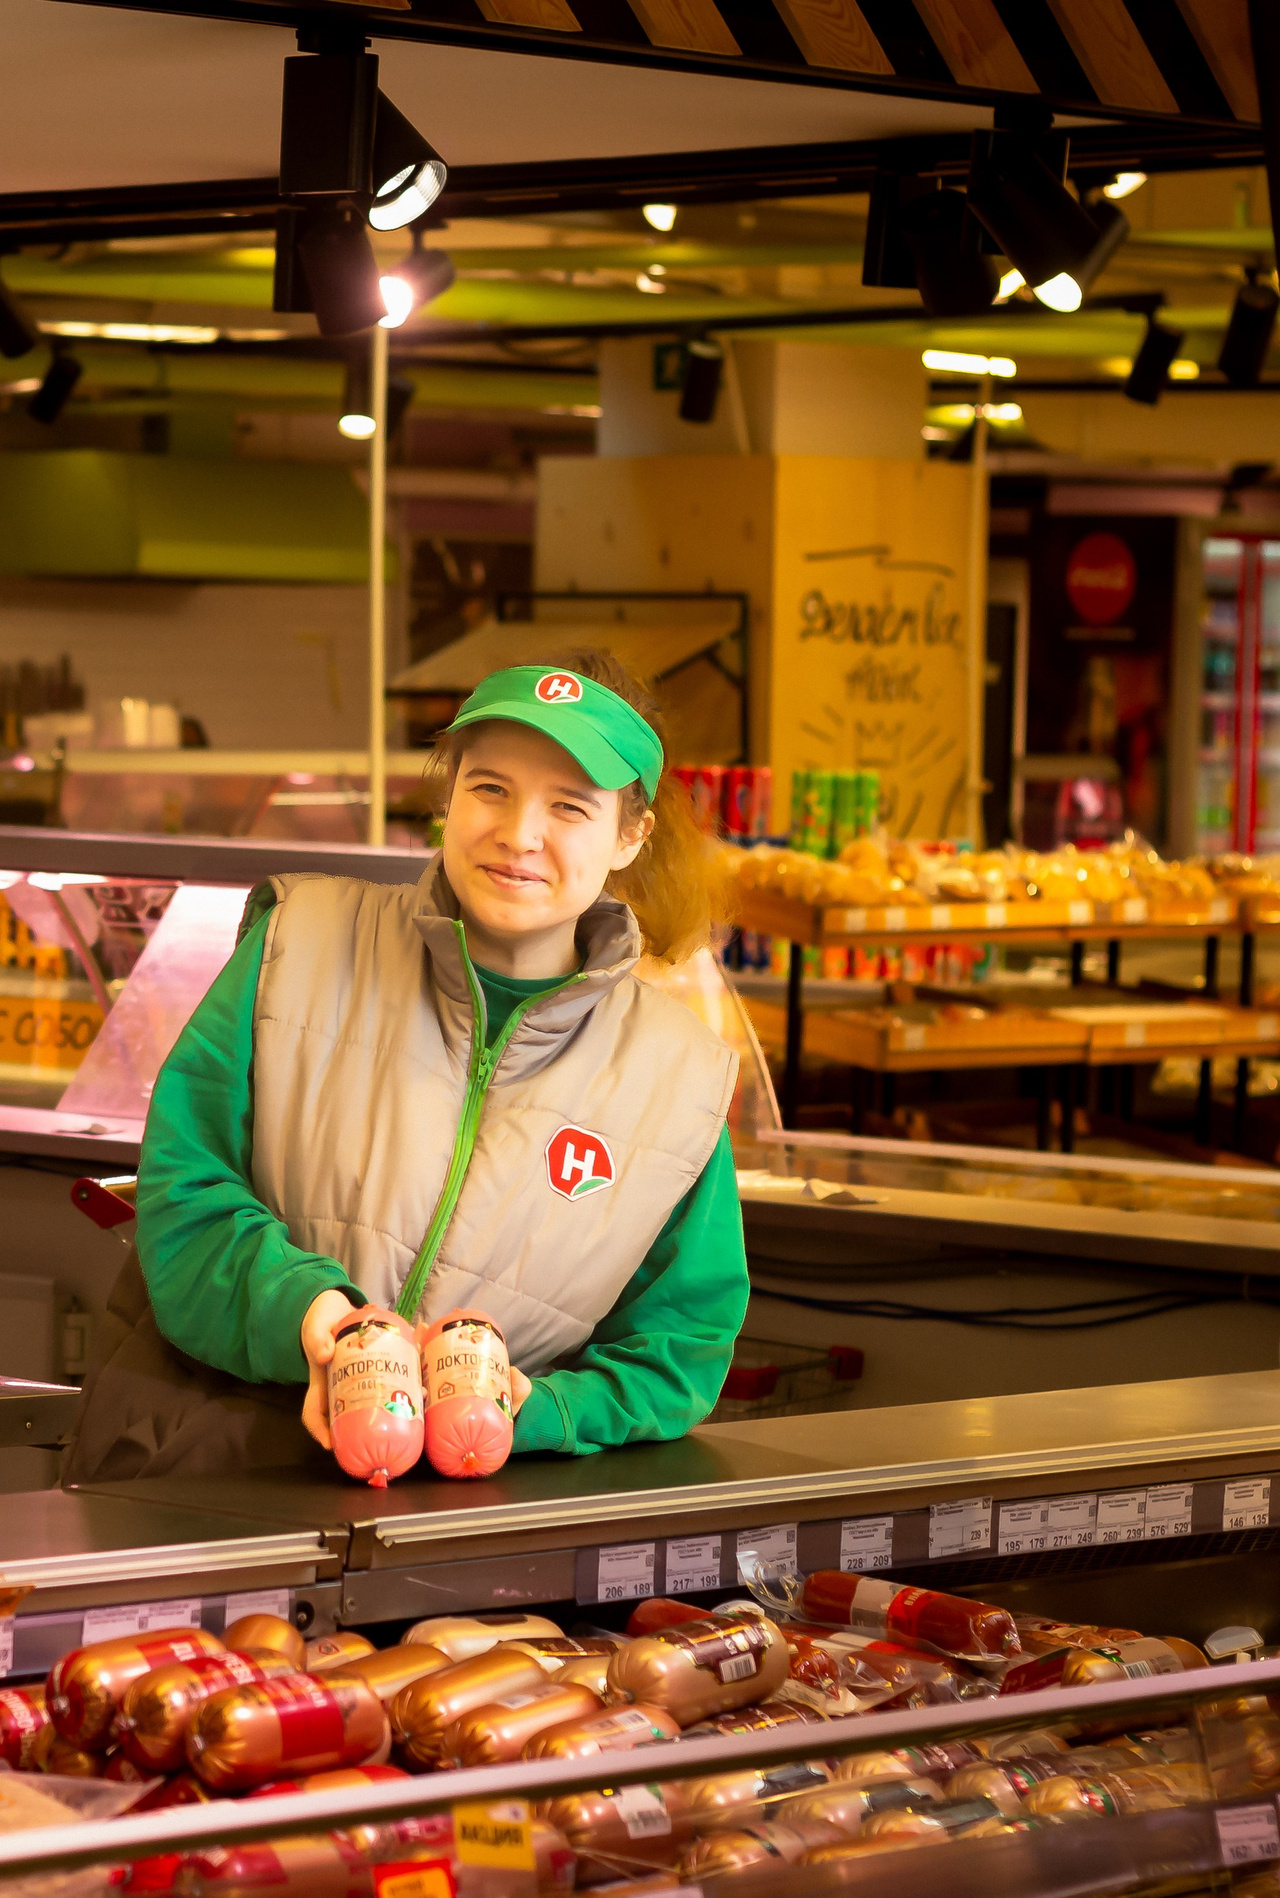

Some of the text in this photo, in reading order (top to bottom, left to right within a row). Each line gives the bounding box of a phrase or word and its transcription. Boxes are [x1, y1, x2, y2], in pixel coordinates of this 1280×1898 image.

[332, 1358, 409, 1388] ДОКТОРСКАЯ
[1229, 1516, 1244, 1529] 146
[1252, 1513, 1267, 1526] 135
[1126, 1527, 1142, 1540] 239
[1150, 1524, 1166, 1537] 576
[1173, 1521, 1189, 1534] 529
[1053, 1535, 1068, 1547] 271
[1077, 1531, 1093, 1544] 249
[1102, 1530, 1118, 1543] 260
[1005, 1540, 1021, 1552] 195
[1029, 1537, 1045, 1550] 179
[847, 1557, 863, 1570] 228
[873, 1554, 889, 1567] 209
[673, 1578, 690, 1592] 217
[701, 1574, 717, 1588] 199
[605, 1585, 623, 1599] 206
[634, 1582, 651, 1596] 189
